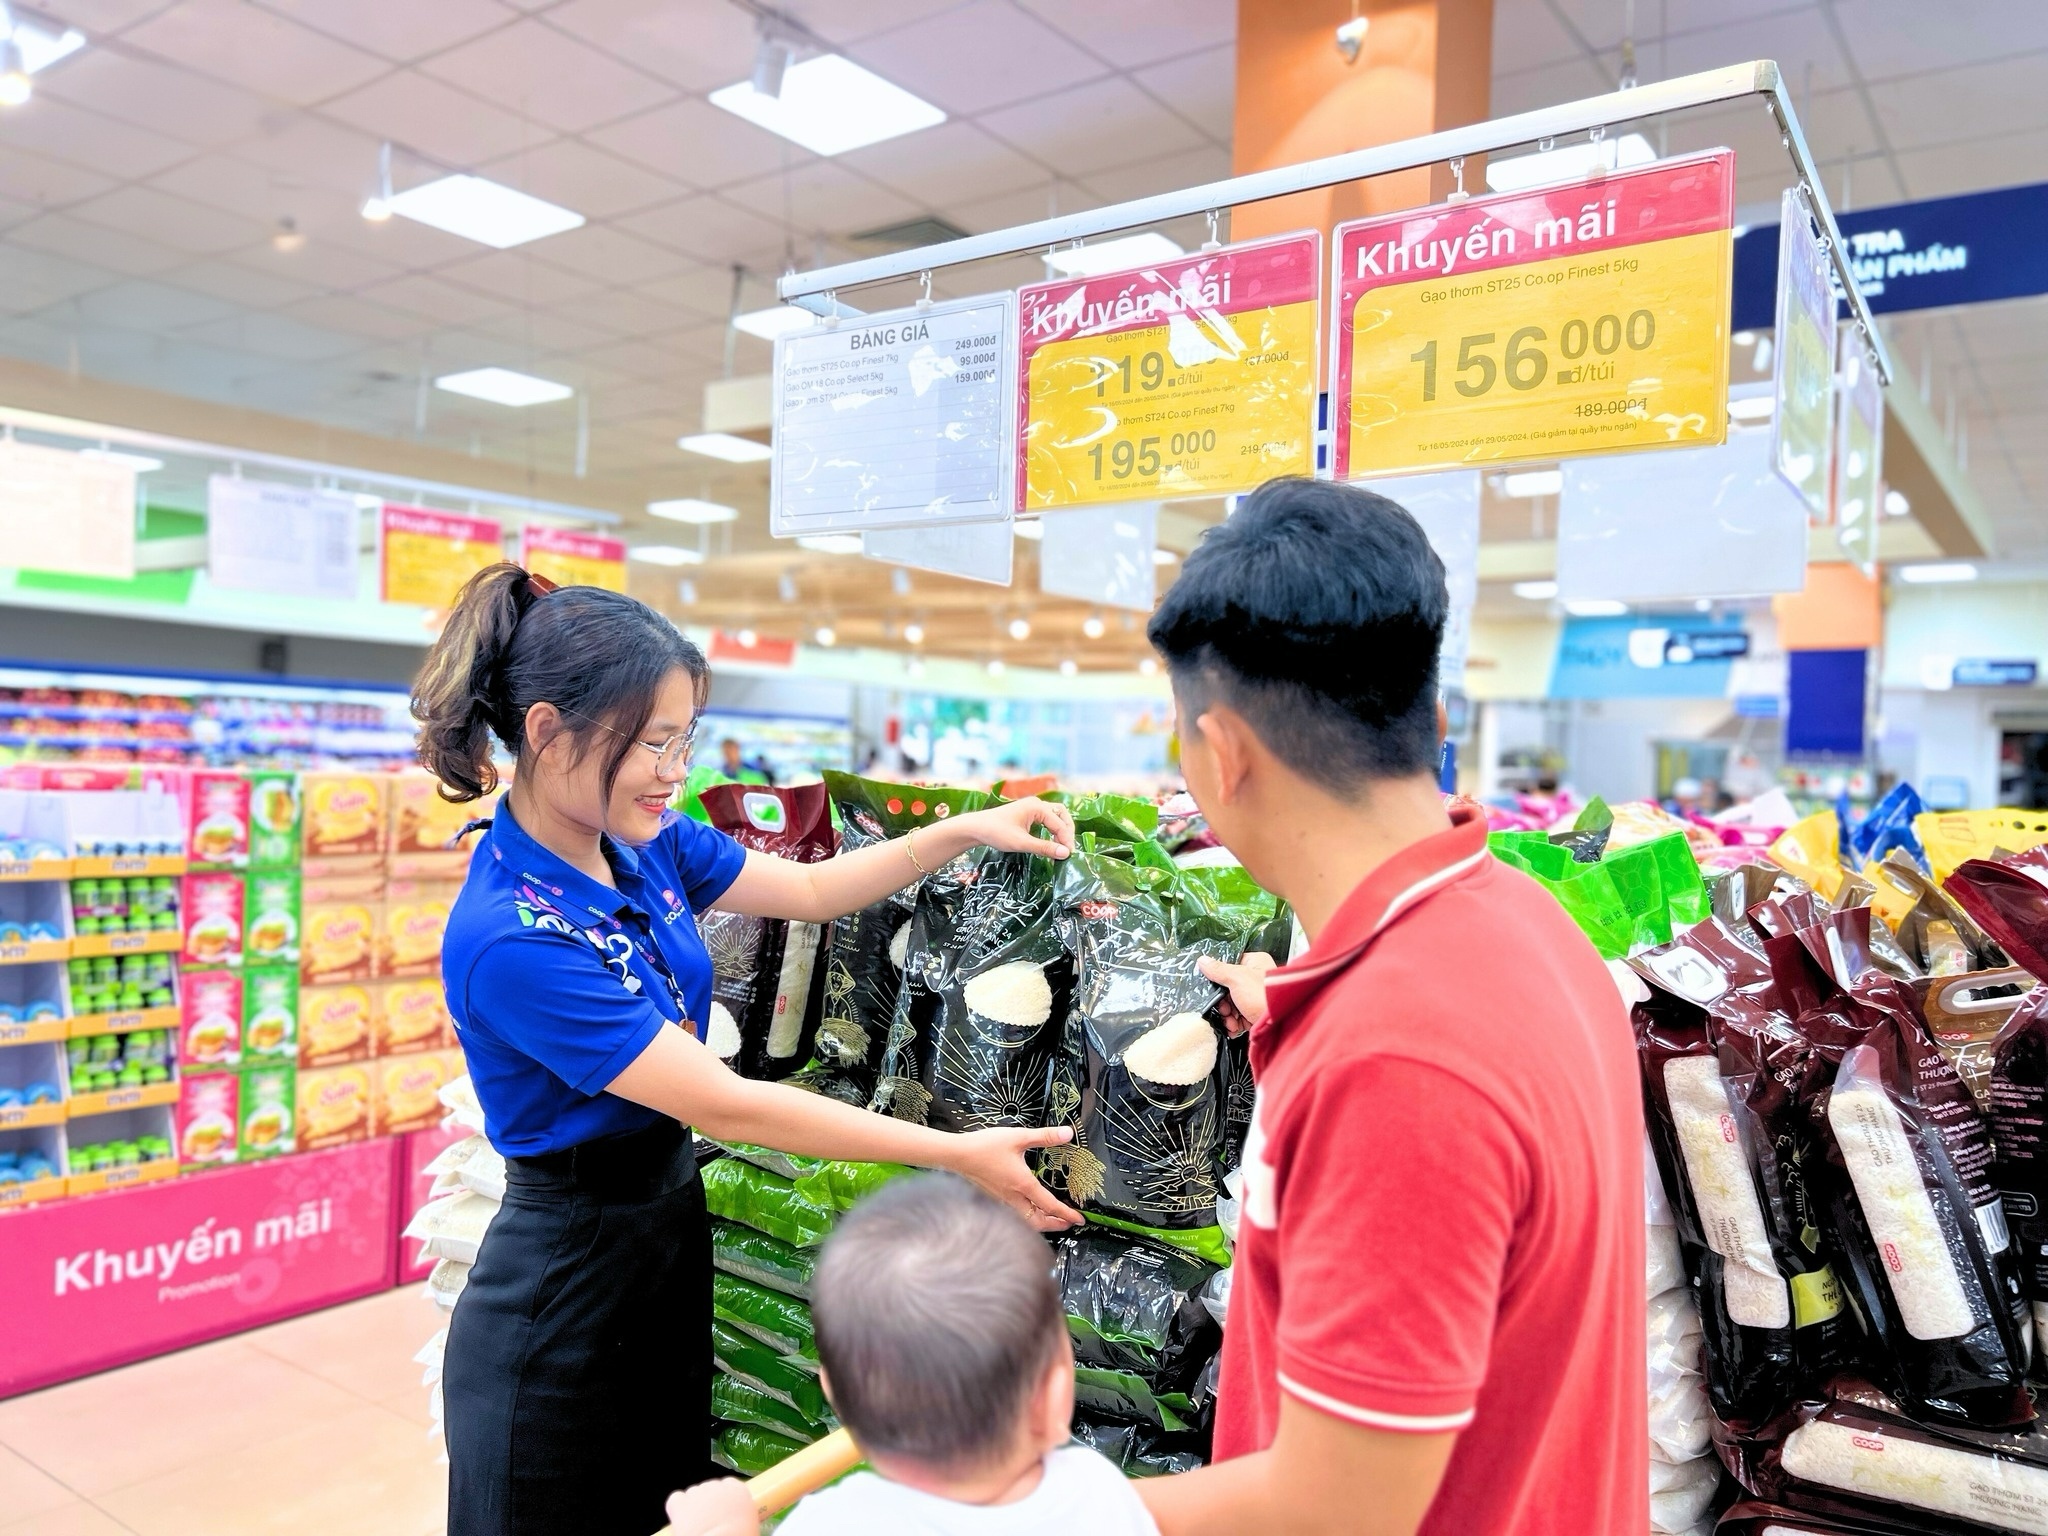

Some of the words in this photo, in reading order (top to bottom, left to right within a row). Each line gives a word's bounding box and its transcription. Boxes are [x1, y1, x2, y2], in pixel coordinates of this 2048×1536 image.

[1357, 217, 1514, 280] Khuyến
[1534, 200, 1617, 249] mãi
[1853, 229, 1904, 256] TRA
[1887, 243, 1967, 278] PHẨM
[1420, 289, 1447, 305] Gạo
[1449, 282, 1483, 300] thơm
[1487, 276, 1521, 293] ST25
[1524, 271, 1564, 288] Co.op
[1569, 264, 1610, 282] Finest
[1613, 257, 1639, 274] 5kg
[850, 328, 896, 350] BẢNG
[901, 320, 929, 341] GIÁ
[955, 335, 996, 351] 249.000đ
[1147, 327, 1167, 337] ST21
[862, 355, 884, 366] Finest
[885, 353, 899, 363] 7kg
[960, 352, 996, 367] 99.000đ
[847, 373, 869, 384] Select
[870, 371, 884, 381] 5kg
[1177, 370, 1203, 386] đ/túi
[1570, 361, 1615, 385] đ/túi
[884, 386, 898, 396] 5kg
[1123, 414, 1143, 426] thơm
[1145, 411, 1166, 423] ST24
[1167, 409, 1192, 422] Co.op
[1193, 405, 1218, 417] Finest
[1220, 403, 1235, 415] 7kg
[1574, 398, 1648, 418] 189.000đ
[1470, 436, 1484, 446] đến
[1530, 428, 1547, 442] (Giá
[1548, 427, 1567, 440] giảm
[1568, 425, 1578, 436] tại
[1579, 424, 1599, 436] quầy
[1600, 422, 1613, 433] thu
[1614, 420, 1637, 433] ngân)
[1082, 904, 1117, 916] COOP
[54, 1218, 241, 1297] Khuyến
[254, 1199, 332, 1248] mãi
[1885, 1244, 1901, 1272] COOP
[158, 1272, 242, 1303] Promotion
[1853, 1437, 1884, 1450] COOP
